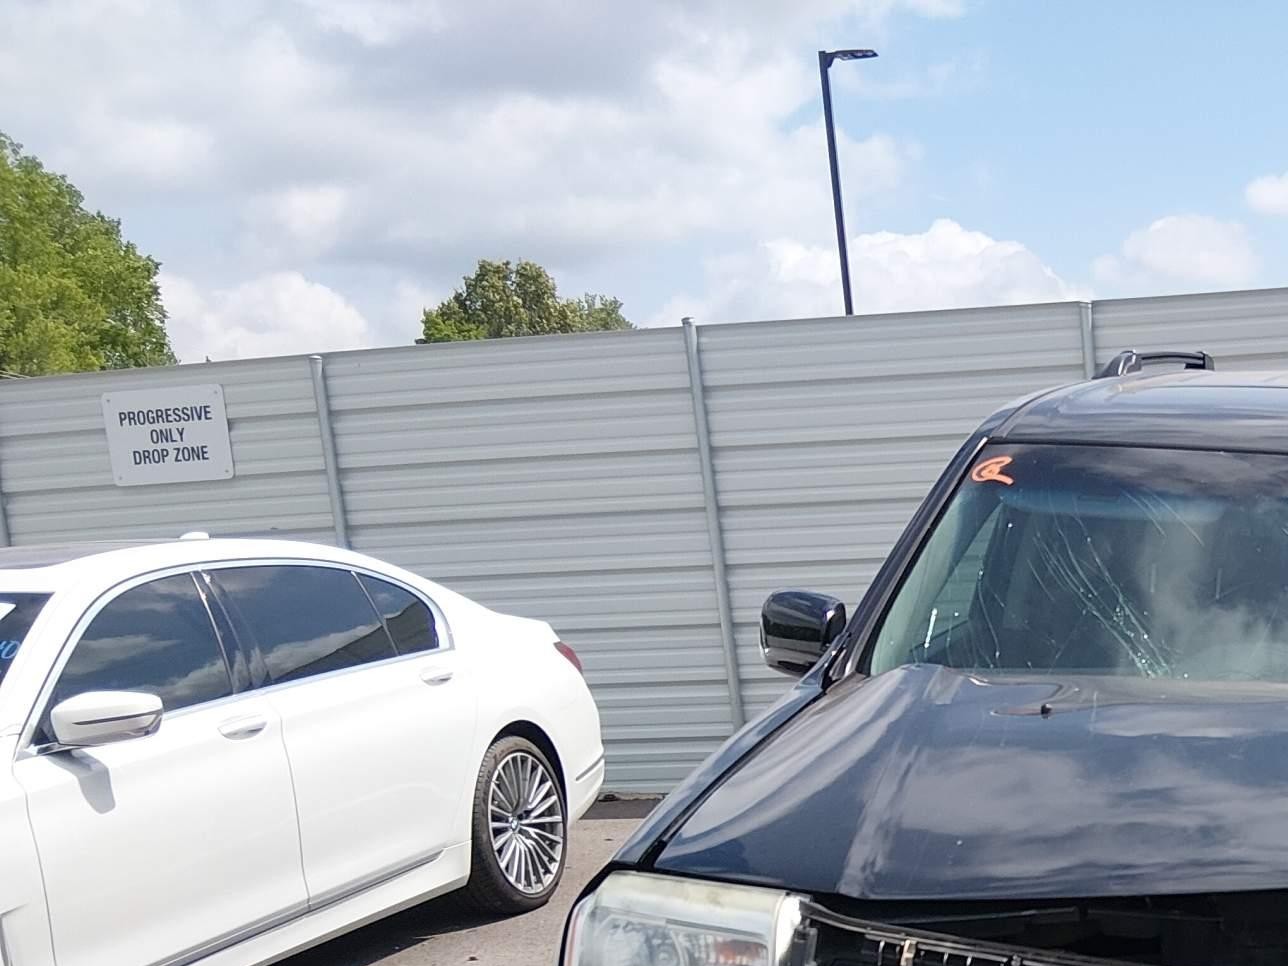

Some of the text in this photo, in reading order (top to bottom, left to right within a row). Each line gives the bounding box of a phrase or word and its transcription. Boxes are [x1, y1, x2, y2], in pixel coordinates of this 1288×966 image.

[118, 405, 212, 426] PROGRESSIVE
[150, 427, 185, 444] ONLY
[132, 445, 209, 465] DROP ZONE
